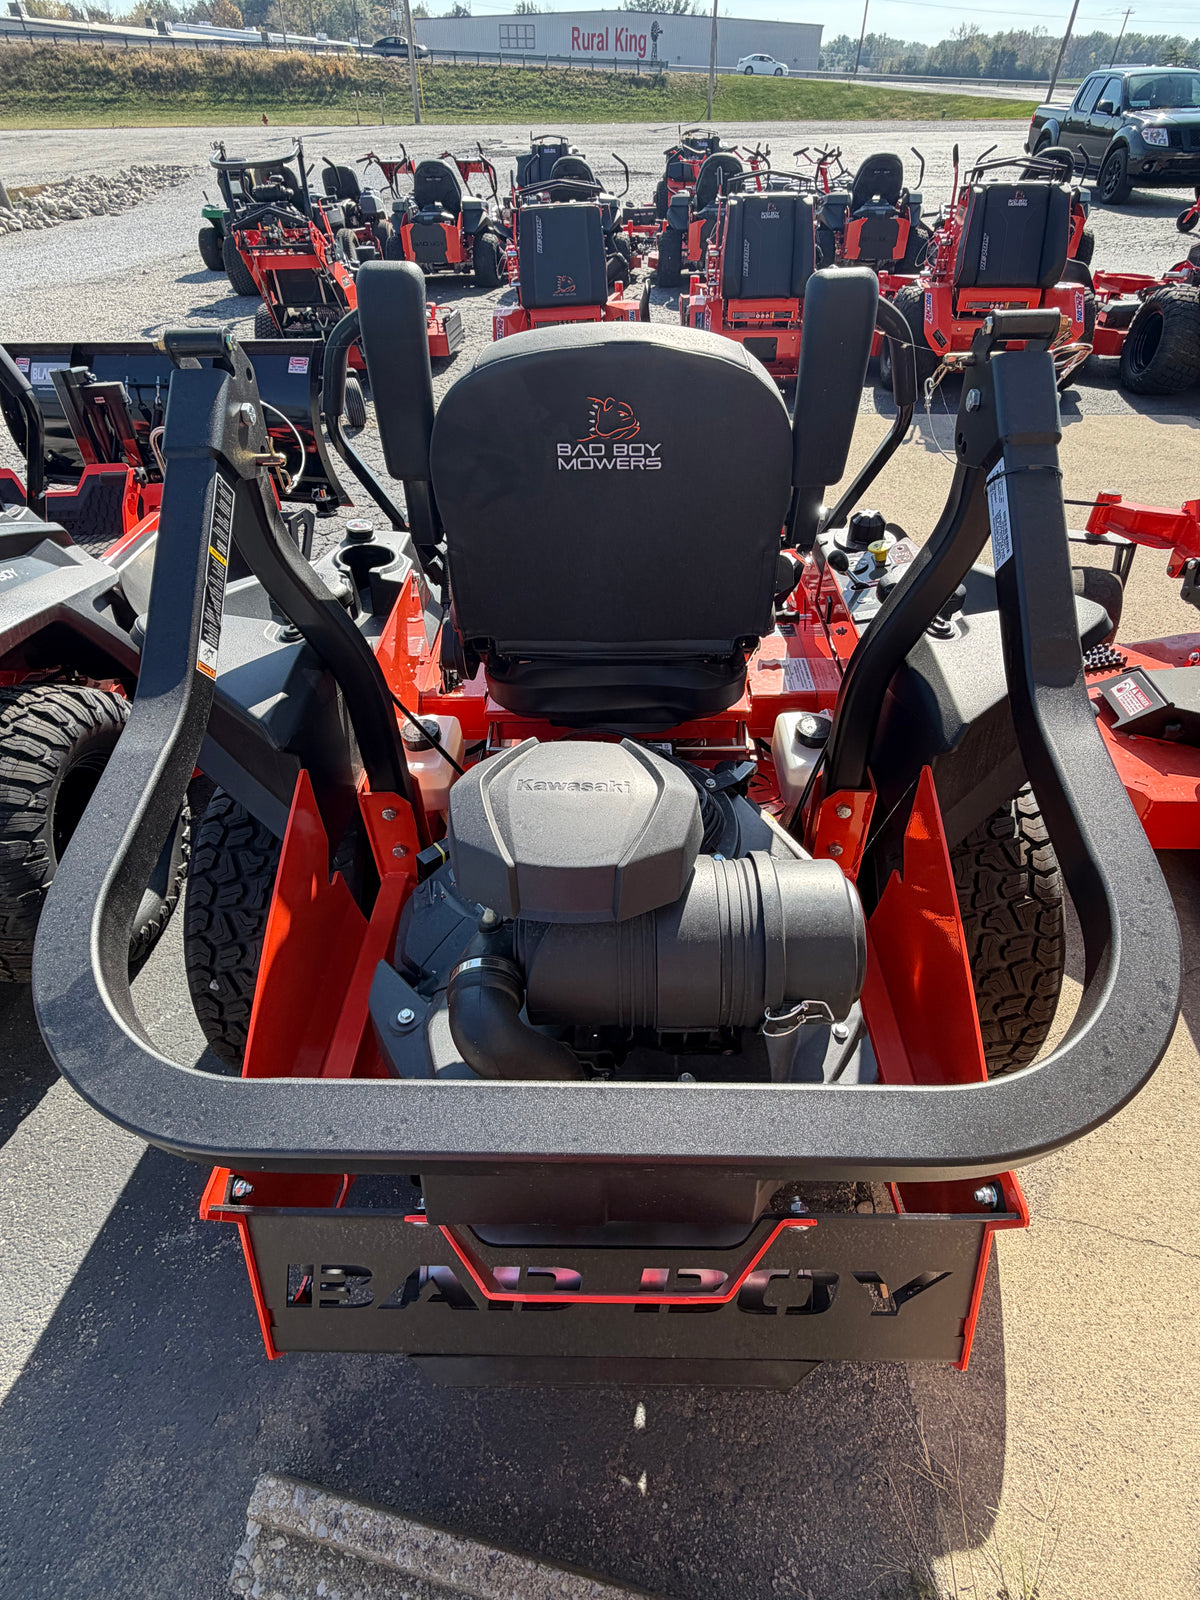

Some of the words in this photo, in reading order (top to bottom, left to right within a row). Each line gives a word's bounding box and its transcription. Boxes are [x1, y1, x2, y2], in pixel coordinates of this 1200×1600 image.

[571, 26, 609, 51] Rural
[614, 27, 647, 58] King
[557, 443, 605, 456] BAD
[613, 443, 661, 456] BOY
[558, 457, 662, 470] MOWERS
[516, 778, 630, 793] Kawasaki
[286, 1263, 583, 1311] BAD
[634, 1268, 953, 1316] BOY
